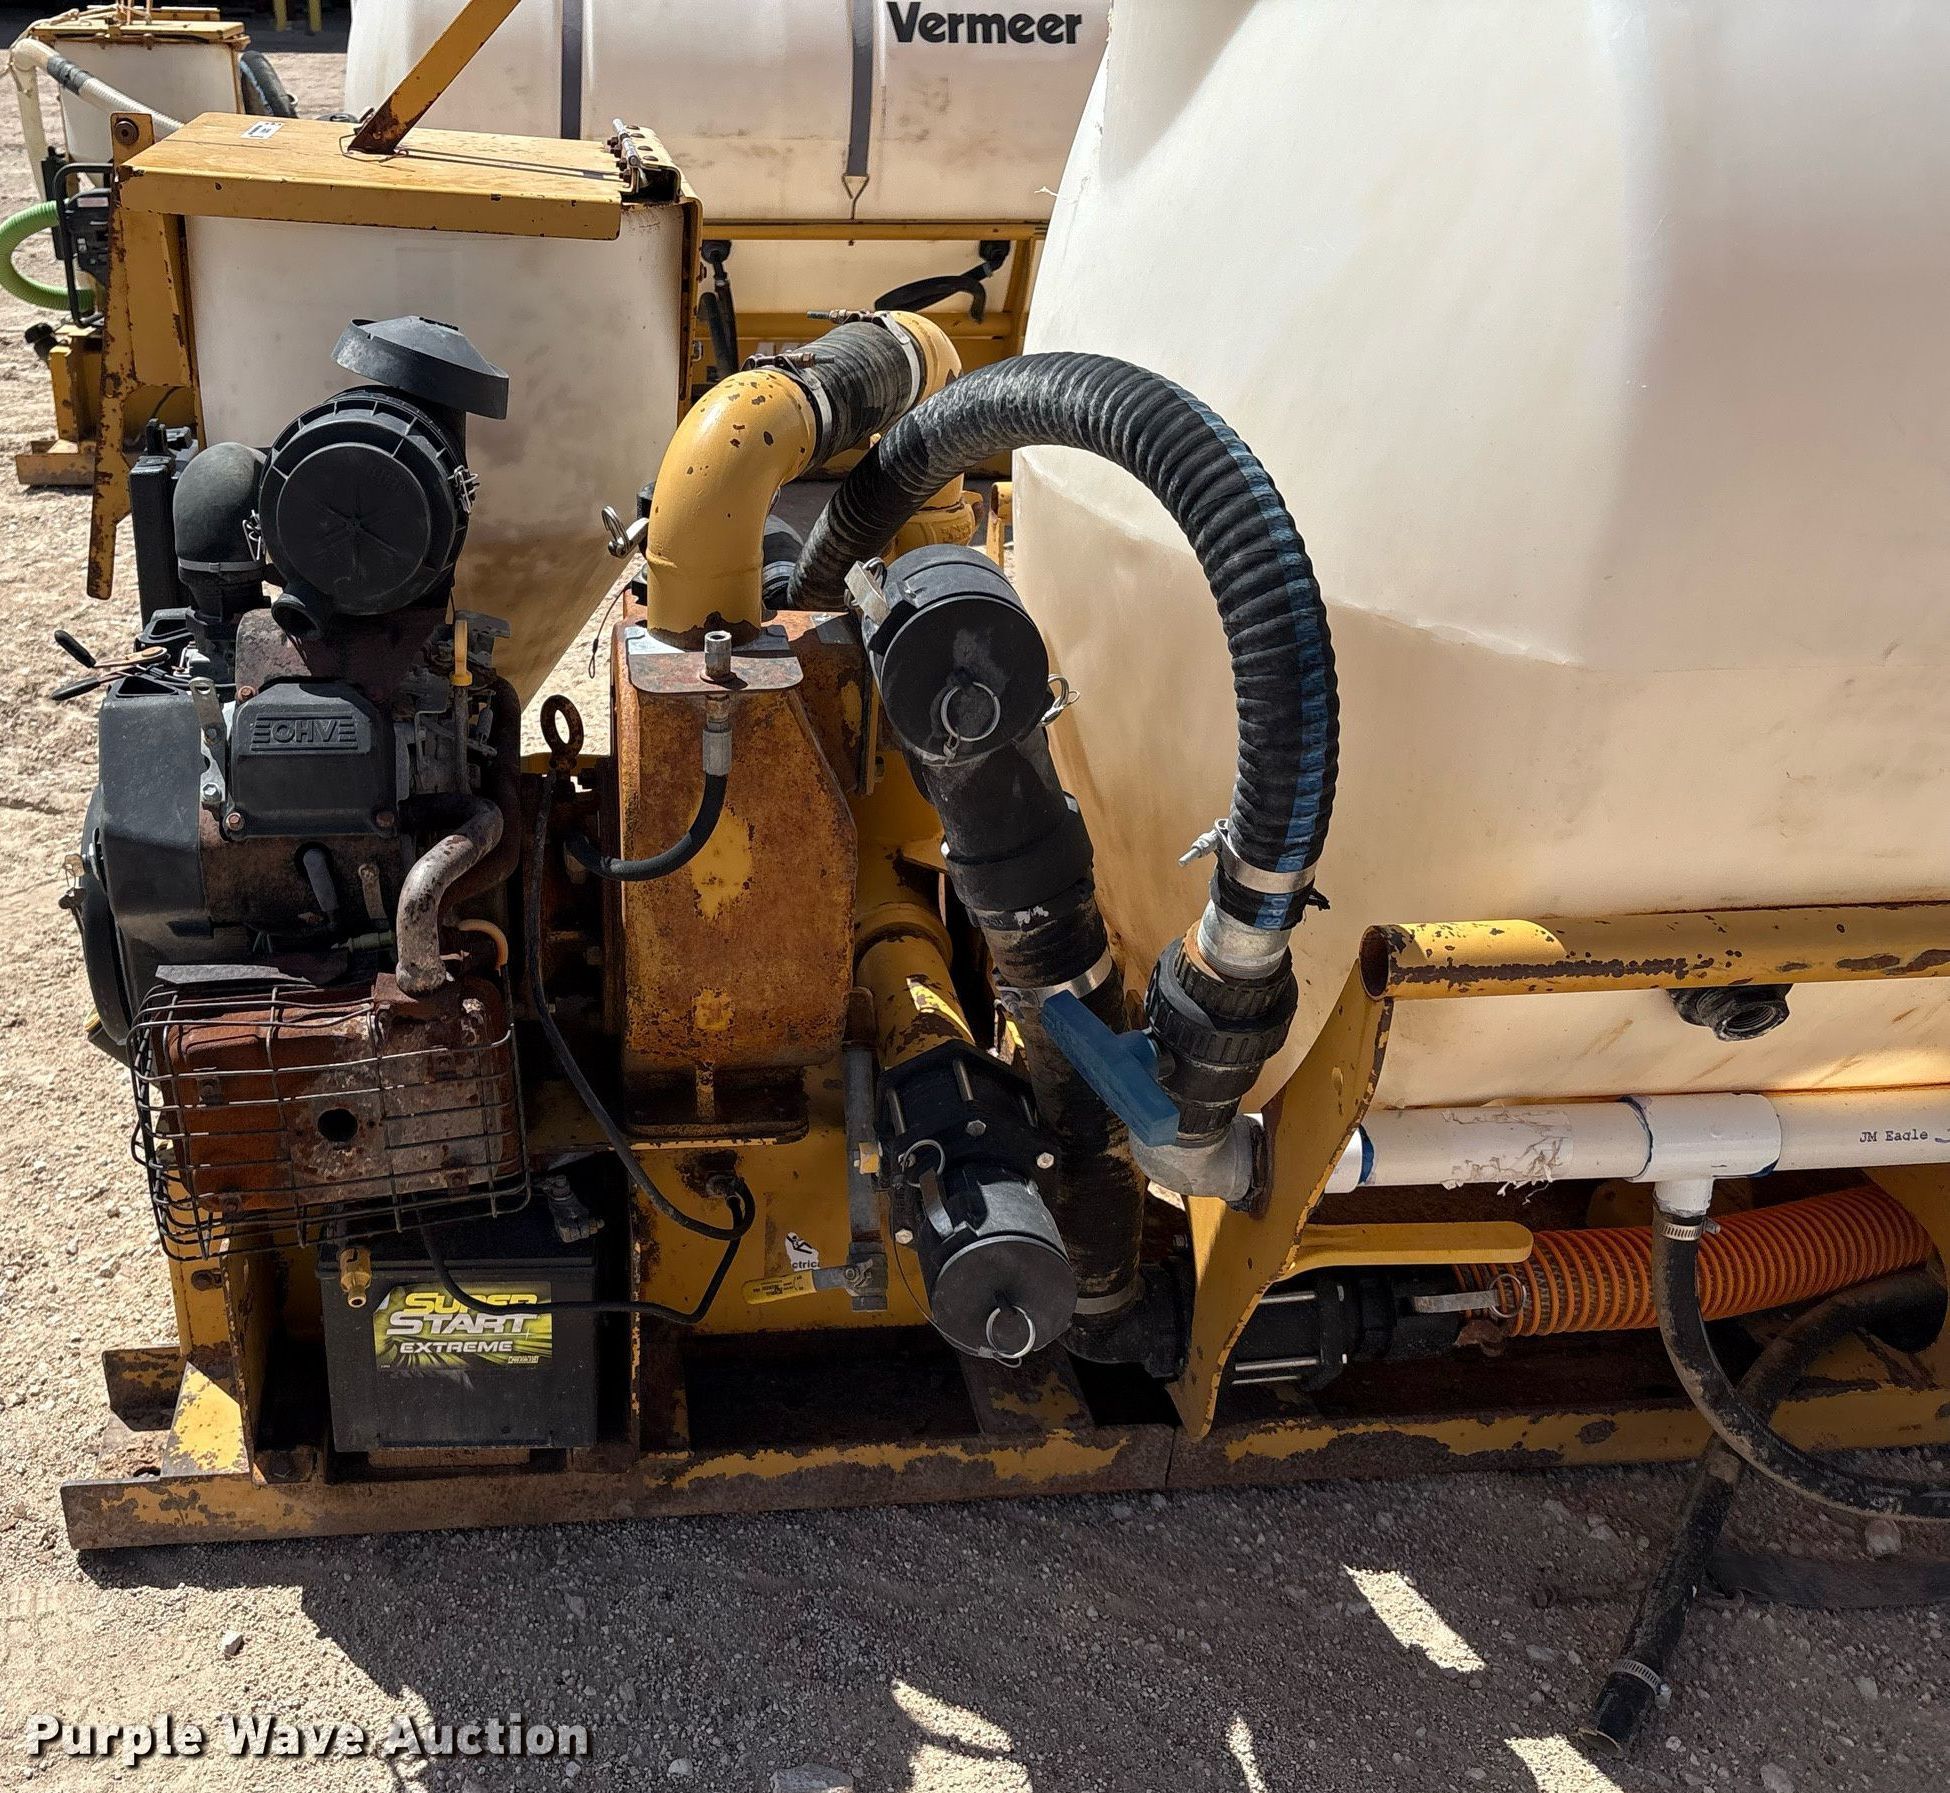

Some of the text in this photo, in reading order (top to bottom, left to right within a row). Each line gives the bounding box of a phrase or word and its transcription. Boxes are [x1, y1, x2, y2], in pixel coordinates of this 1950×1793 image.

[886, 1, 1082, 44] Vermeer
[271, 719, 338, 743] OHV
[1859, 1131, 1878, 1143] JM
[386, 1311, 538, 1336] START
[400, 1340, 513, 1354] EXTREME
